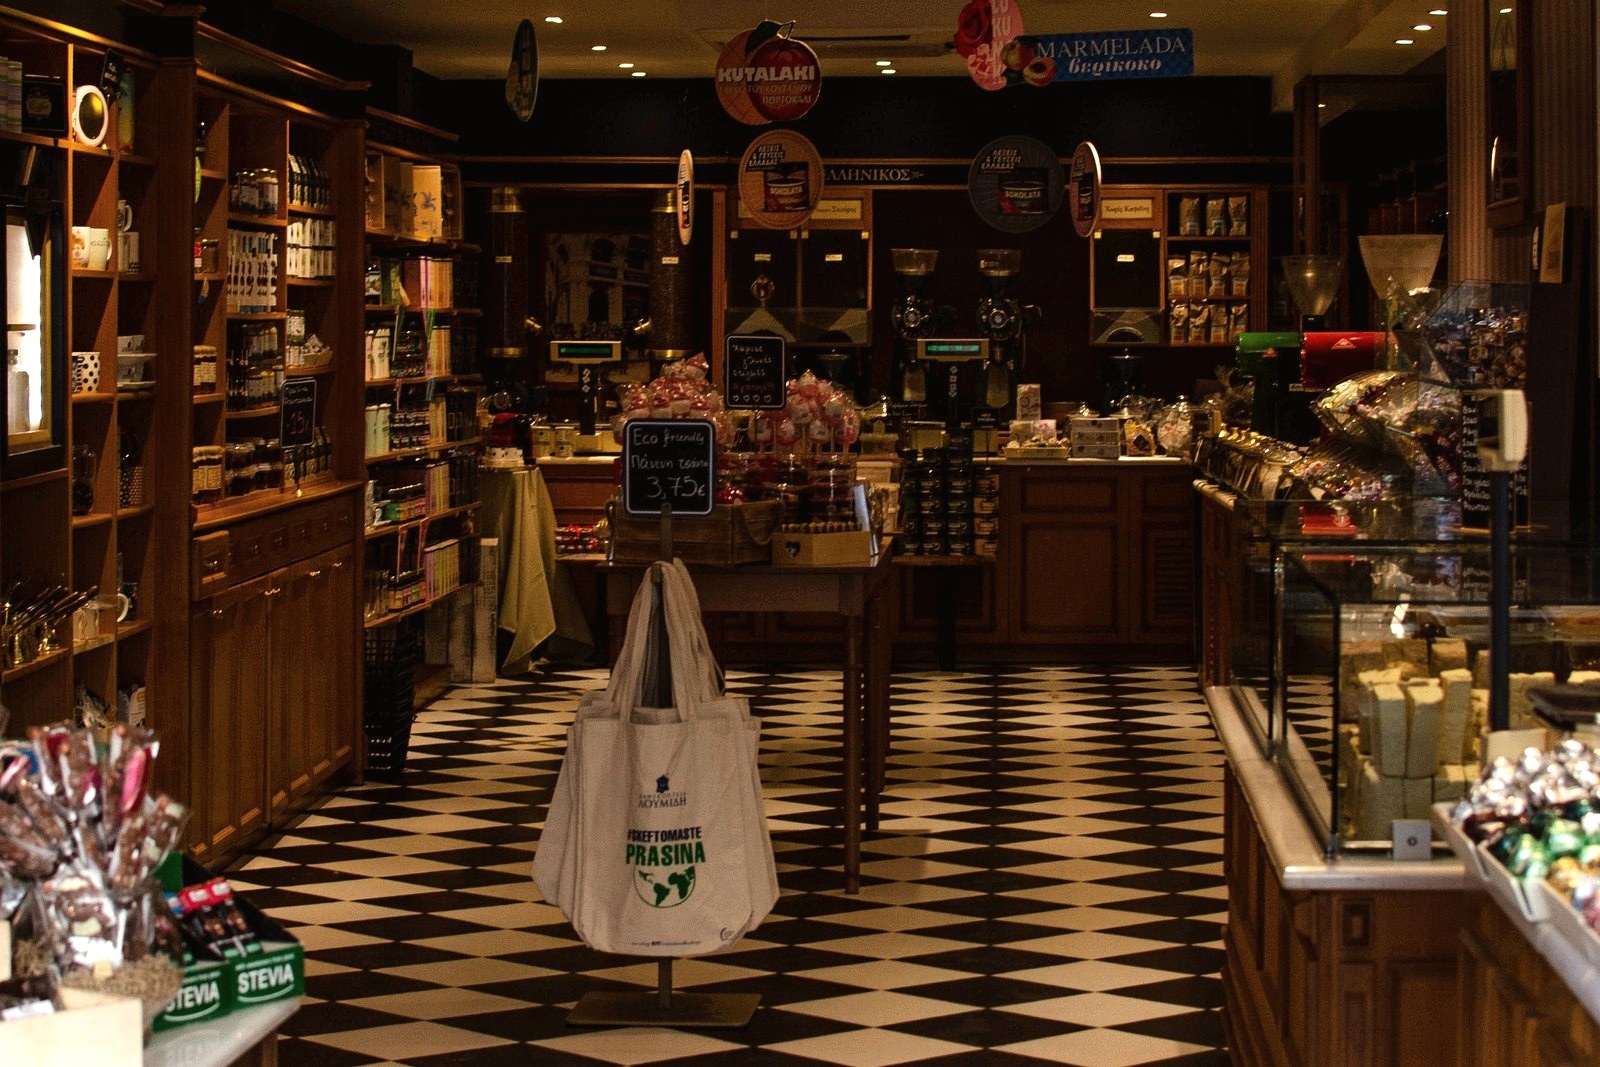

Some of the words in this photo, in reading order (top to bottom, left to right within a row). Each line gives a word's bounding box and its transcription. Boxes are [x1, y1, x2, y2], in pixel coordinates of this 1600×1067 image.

[1037, 36, 1186, 58] MARMELADA
[719, 65, 815, 82] KUTALAKI
[1068, 56, 1162, 76] βερίκοκο
[633, 428, 658, 446] Eco
[662, 427, 705, 448] friendly
[646, 475, 706, 500] 3,75€
[638, 797, 687, 809] ΛΟΥΜΙΔΗ
[627, 826, 702, 842] #SKEFTOMASTE
[626, 841, 706, 866] PRASINA
[237, 963, 295, 995] STEVIA
